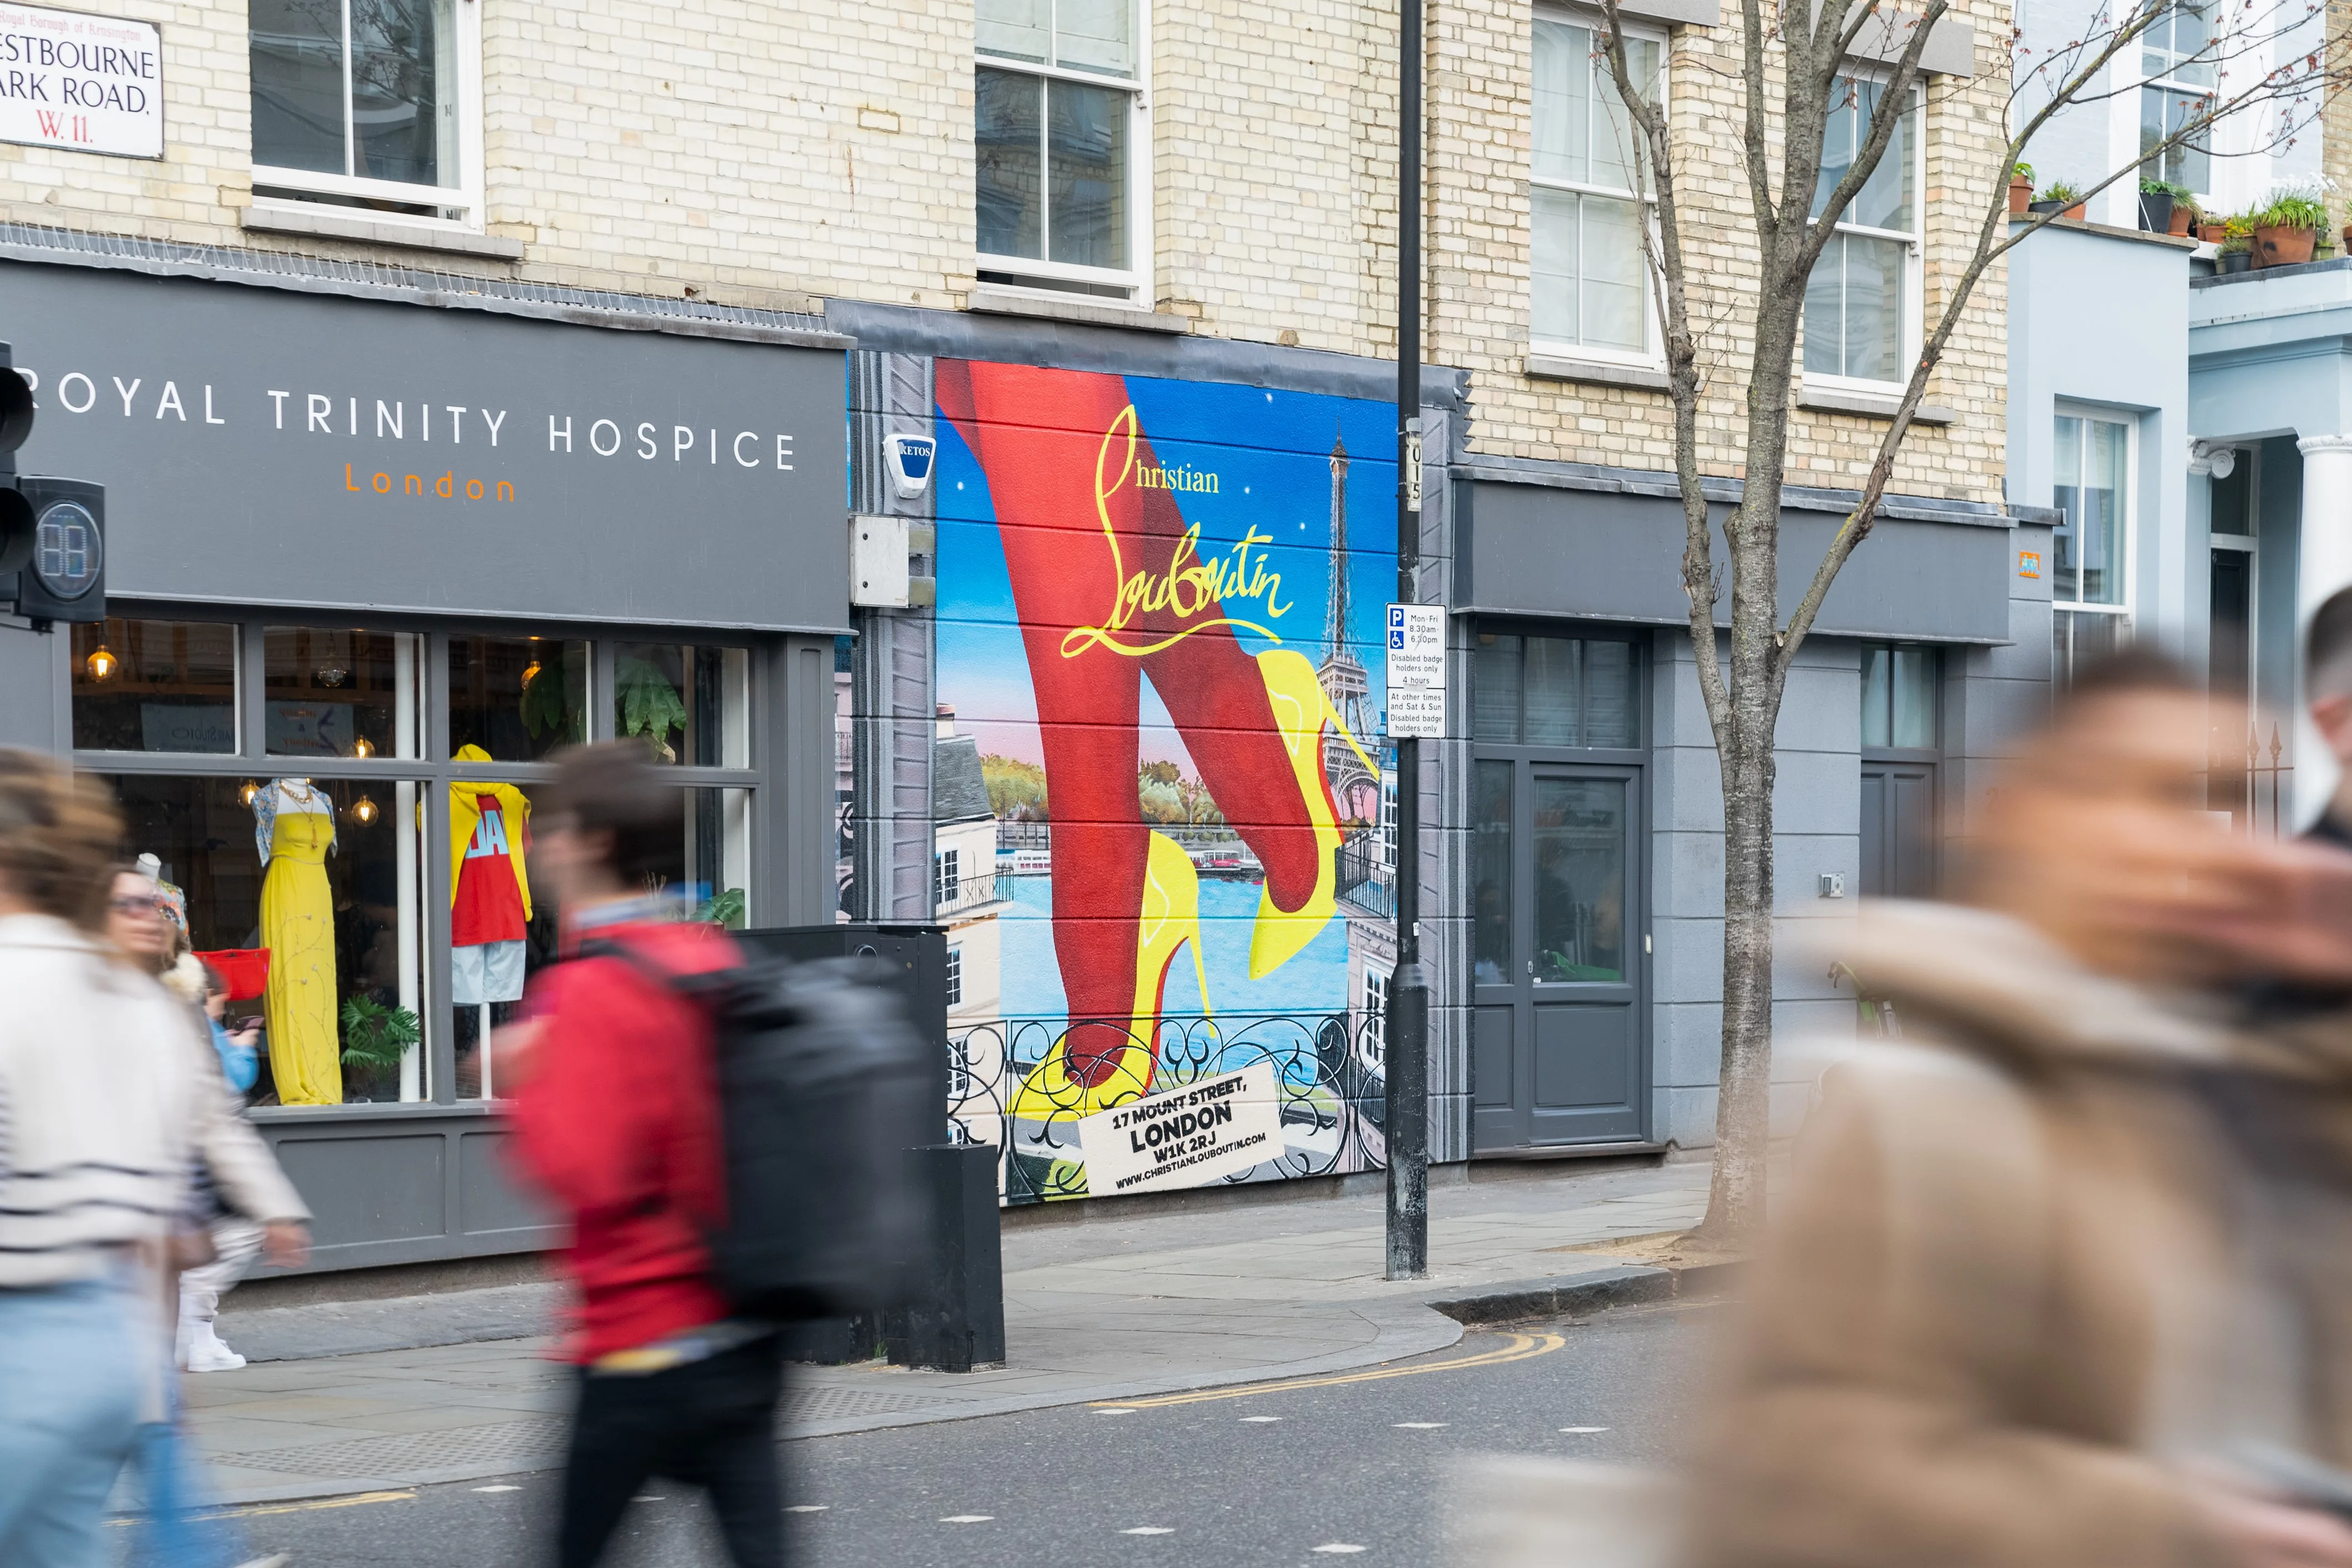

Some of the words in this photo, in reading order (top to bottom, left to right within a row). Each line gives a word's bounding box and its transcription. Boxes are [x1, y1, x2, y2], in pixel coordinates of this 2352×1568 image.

[30, 14, 69, 35] Borough
[74, 22, 85, 34] of
[89, 23, 141, 43] Kensington
[63, 77, 150, 115] ROAD.
[267, 389, 506, 446] TRINITY
[549, 414, 794, 471] HOSPICE
[345, 463, 514, 502] London
[1392, 610, 1402, 626] P
[1411, 636, 1438, 644] 6.30pm
[1391, 654, 1421, 662] Disabled
[1423, 654, 1443, 663] badge
[1424, 665, 1438, 673] only
[1422, 714, 1442, 723] badge
[1112, 1112, 1129, 1129] 17
[1132, 1095, 1187, 1124] MOUNT
[1189, 1076, 1247, 1105] STREET,
[1130, 1100, 1232, 1154] LONDON
[1116, 1132, 1266, 1189] WWW.CHRISTIANLOUBOUTIN.COM
[1153, 1141, 1187, 1164] W1K
[1189, 1130, 1216, 1151] 2RJ
